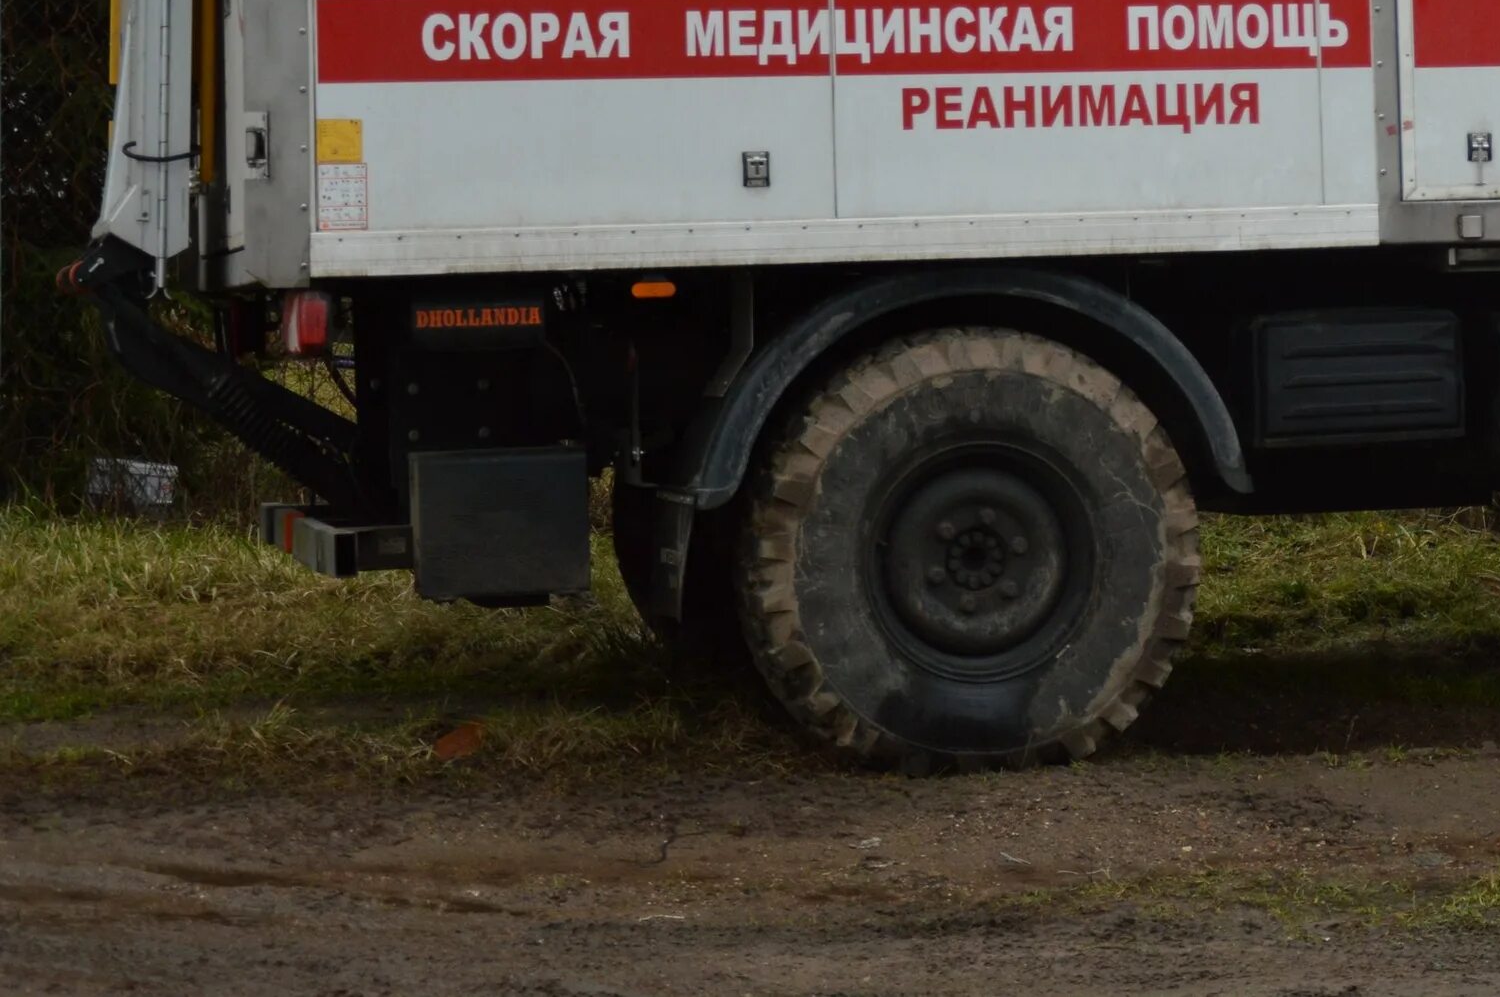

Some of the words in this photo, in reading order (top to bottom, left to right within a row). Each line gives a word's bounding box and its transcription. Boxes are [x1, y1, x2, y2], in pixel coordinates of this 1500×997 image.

[421, 11, 631, 62] СКОРАЯ
[685, 5, 1075, 66] МЕДИЦИНСКАЯ
[1127, 3, 1349, 56] ПОМОЩЬ
[902, 82, 1260, 133] РЕАНИМАЦИЯ
[415, 306, 542, 328] DHOLLANDIA
